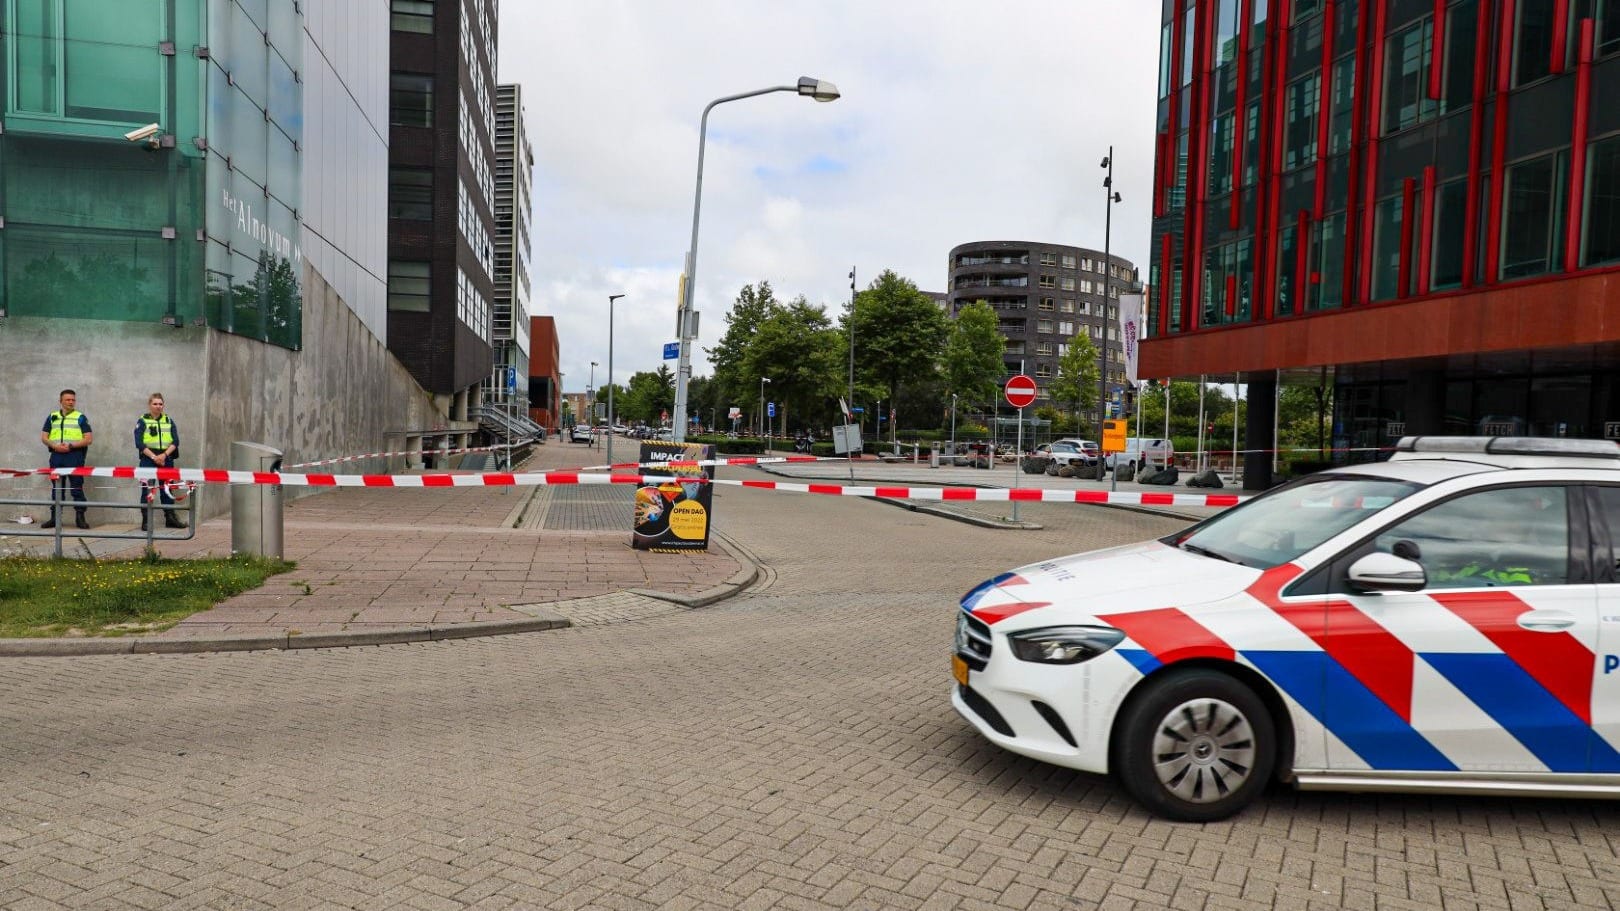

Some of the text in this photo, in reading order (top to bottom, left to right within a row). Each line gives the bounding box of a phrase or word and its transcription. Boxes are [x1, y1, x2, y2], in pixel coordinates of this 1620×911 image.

[223, 189, 291, 258] Het Alnovum
[1484, 424, 1513, 435] FETCH
[650, 451, 685, 462] IMPACT
